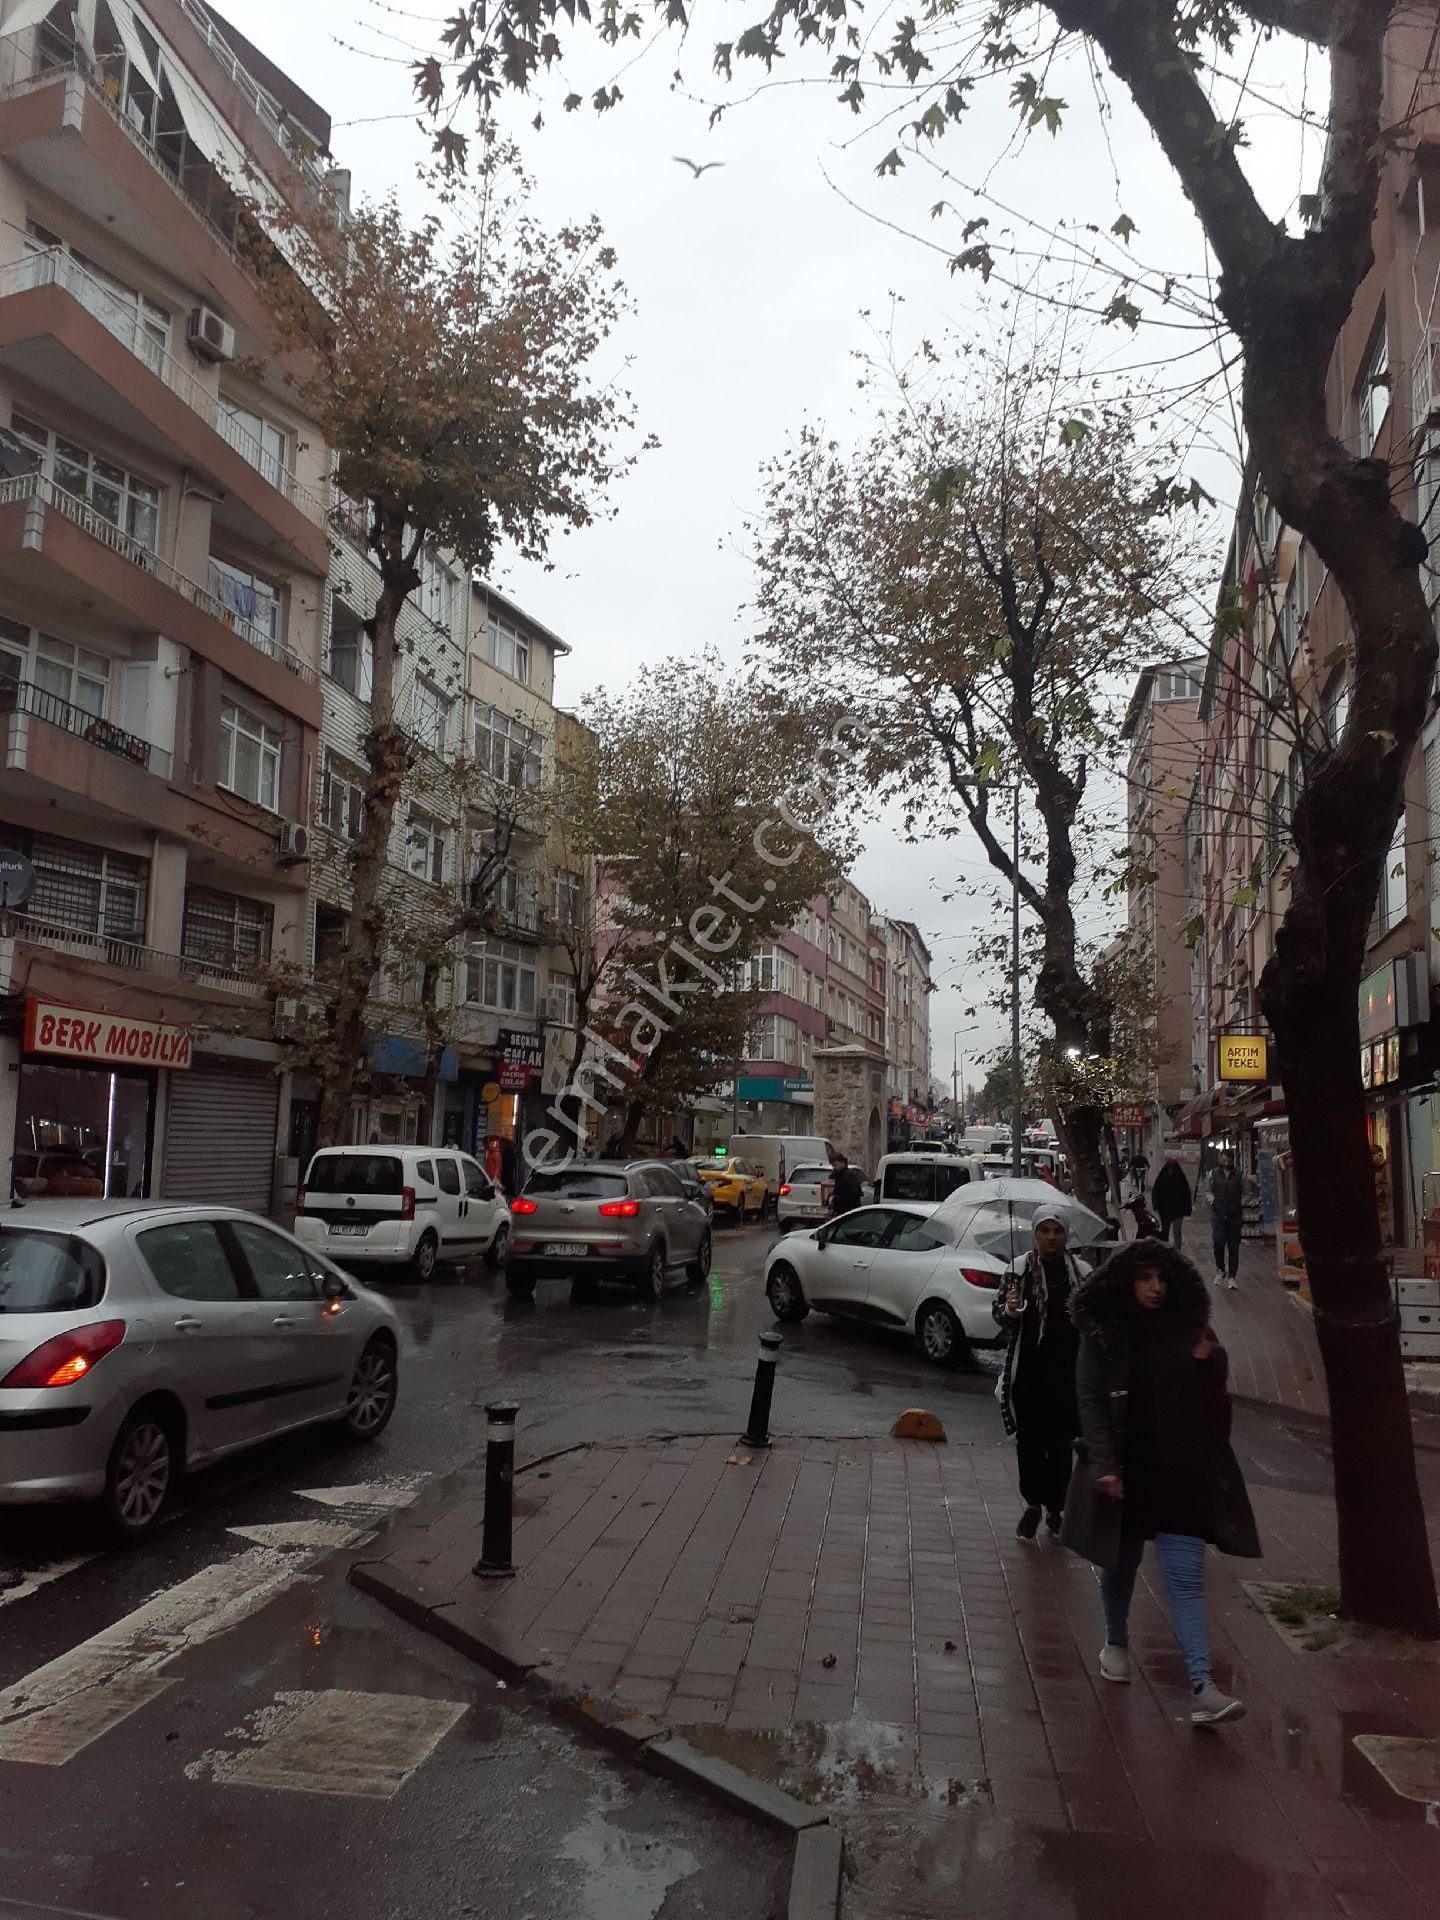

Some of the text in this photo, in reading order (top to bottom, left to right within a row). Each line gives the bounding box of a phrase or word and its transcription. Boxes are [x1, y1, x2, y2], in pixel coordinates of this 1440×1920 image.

[39, 1014, 191, 1065] BERK MOBİLYA
[503, 1047, 543, 1067] EMLAK
[1227, 1047, 1259, 1057] ARTIM
[1227, 1058, 1259, 1069] TEKEL
